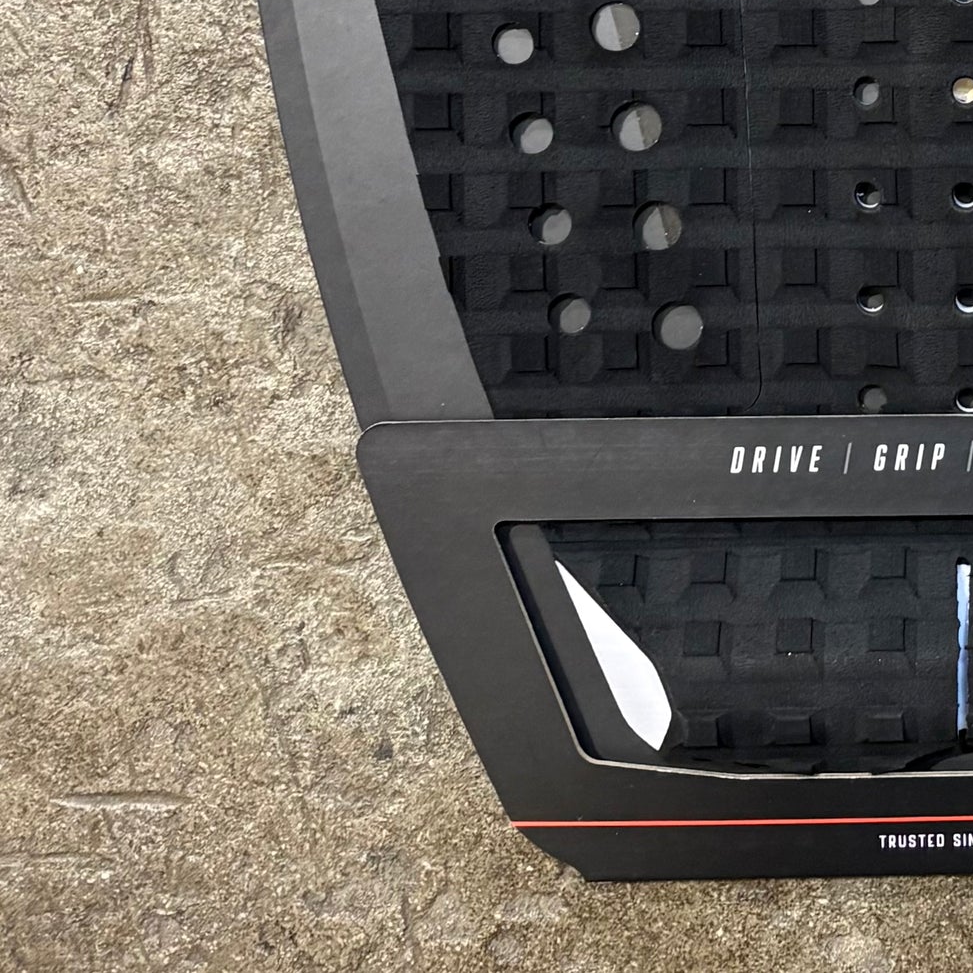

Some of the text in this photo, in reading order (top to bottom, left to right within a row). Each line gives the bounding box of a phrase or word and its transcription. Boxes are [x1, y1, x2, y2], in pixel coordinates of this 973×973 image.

[730, 444, 823, 474] DRIVE
[873, 442, 946, 472] GRIP
[878, 833, 946, 849] TRUSTED
